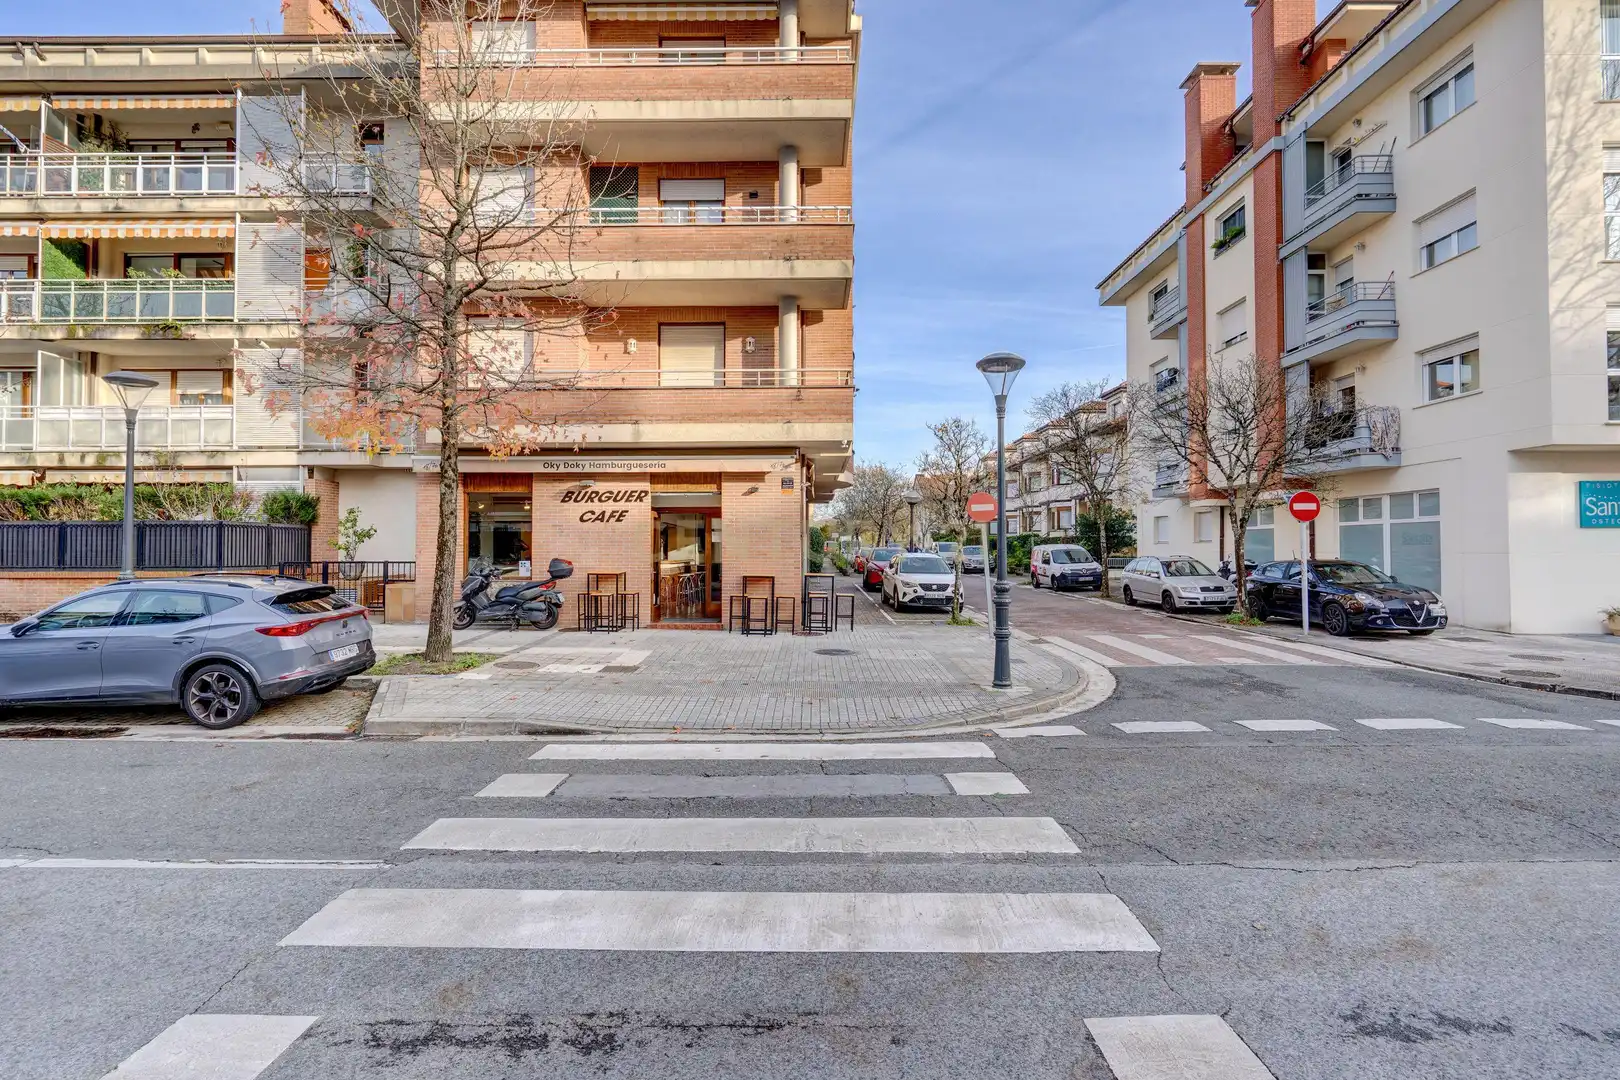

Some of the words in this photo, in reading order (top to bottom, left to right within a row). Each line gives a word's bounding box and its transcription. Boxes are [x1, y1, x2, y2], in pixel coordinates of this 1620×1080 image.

[543, 461, 560, 471] Oky
[563, 461, 586, 470] Doky
[560, 490, 650, 503] BURGUER
[579, 510, 629, 523] CAFE
